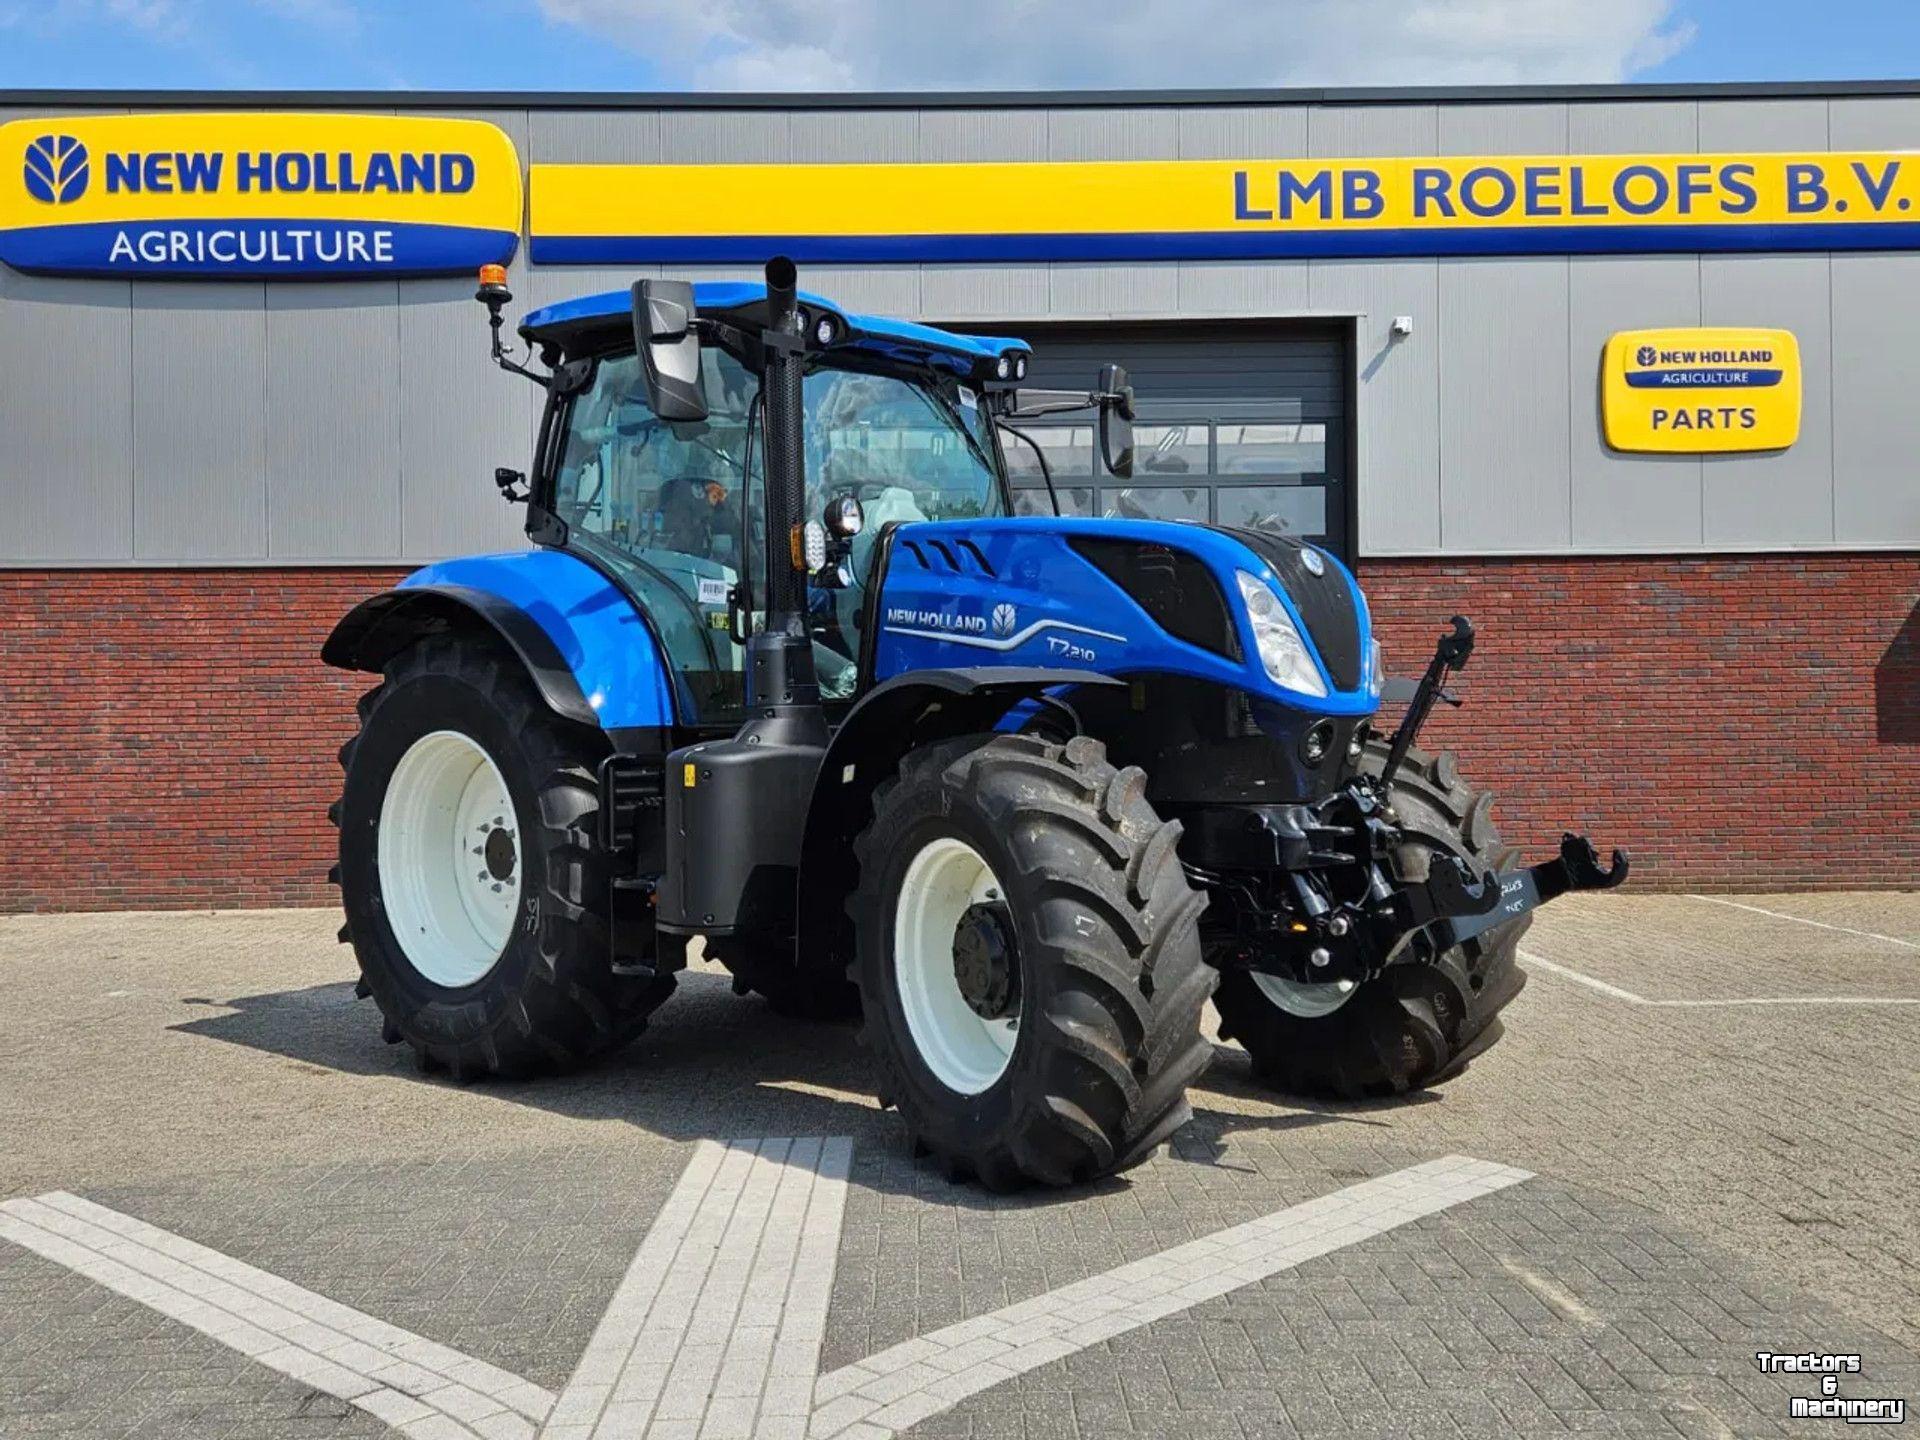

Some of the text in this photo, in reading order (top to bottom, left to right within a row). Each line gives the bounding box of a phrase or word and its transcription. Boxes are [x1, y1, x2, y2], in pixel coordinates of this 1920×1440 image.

[106, 152, 475, 194] NEW HOLLAND
[1234, 161, 1911, 221] LMB ROELOFS B.V.
[109, 230, 394, 263] AGRICULTURE
[1660, 350, 1772, 363] NEW HOLLAND
[1661, 372, 1749, 384] AGRICULTURE
[1652, 408, 1756, 430] PARTS
[887, 608, 987, 632] NEW HOLLAND
[1046, 636, 1096, 662] T7.210
